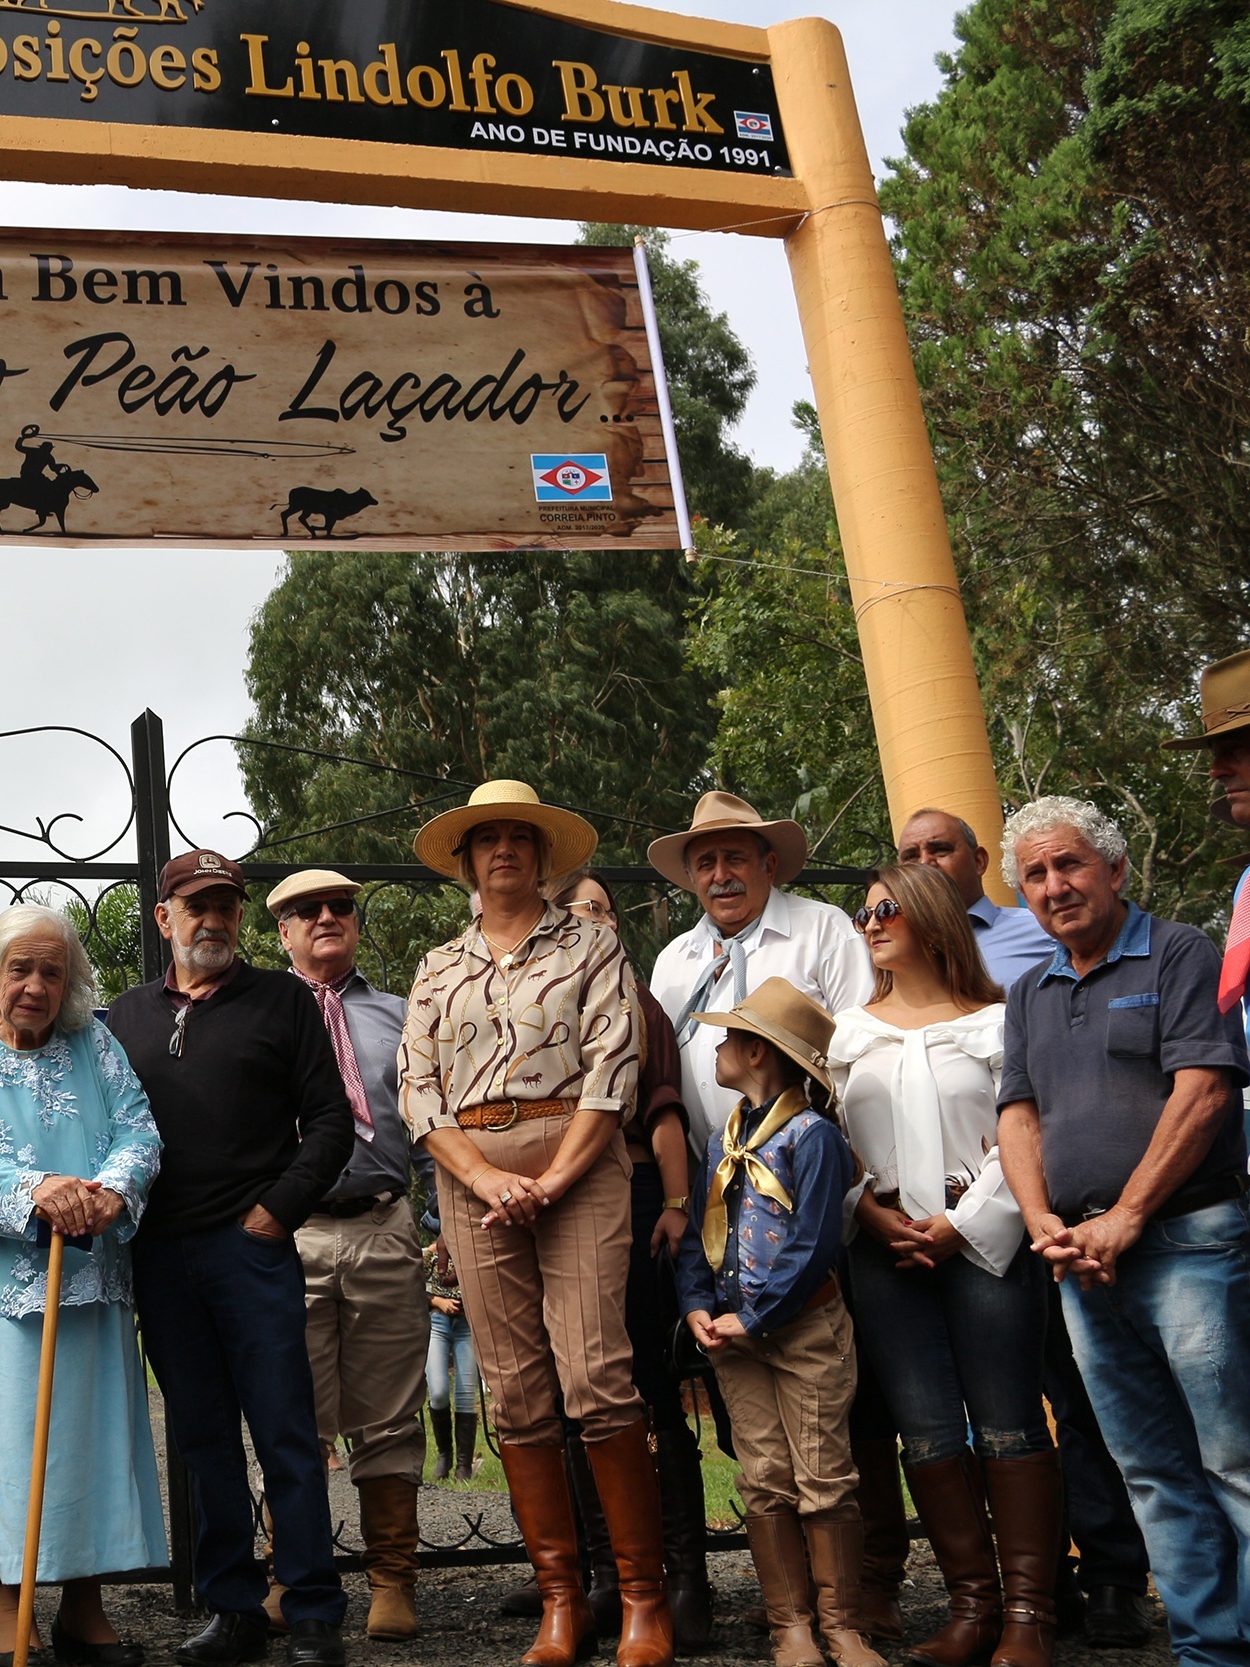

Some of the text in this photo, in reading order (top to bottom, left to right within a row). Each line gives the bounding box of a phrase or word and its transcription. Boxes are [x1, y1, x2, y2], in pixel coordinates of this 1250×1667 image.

[240, 33, 534, 118] Lindolfo
[551, 59, 725, 136] Burk
[470, 121, 770, 168] ANO DE FUNDAÇÃO 1991
[29, 252, 188, 307] Bem
[202, 260, 439, 318] Vindos
[462, 270, 501, 319] à
[48, 331, 258, 417] Peão
[539, 513, 616, 522] CORREIA PINTO
